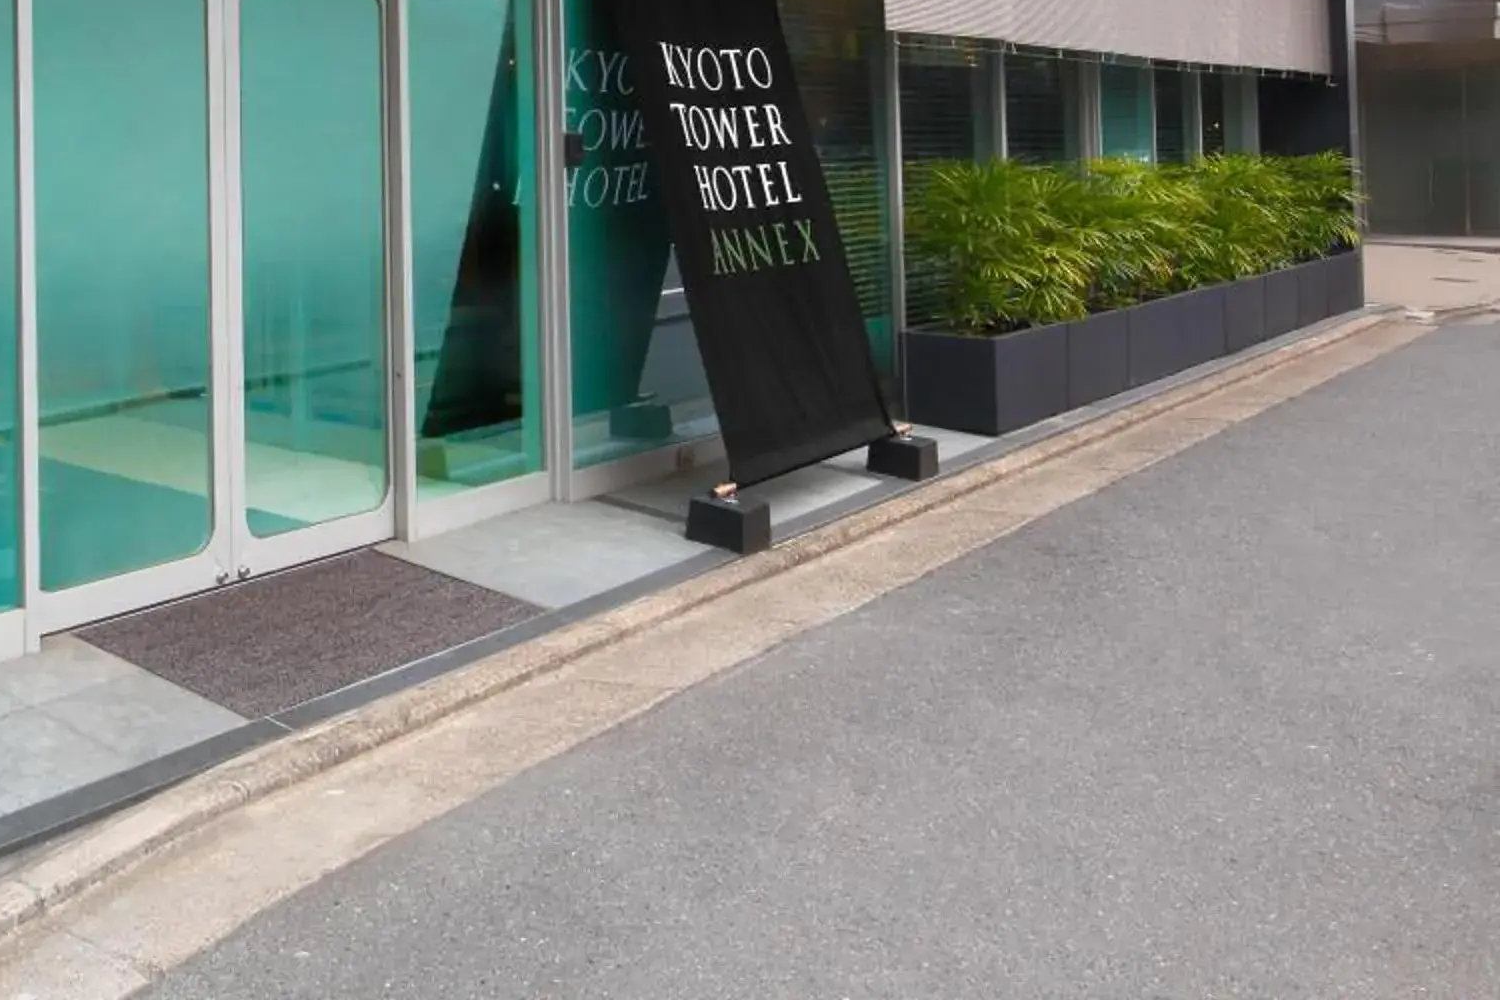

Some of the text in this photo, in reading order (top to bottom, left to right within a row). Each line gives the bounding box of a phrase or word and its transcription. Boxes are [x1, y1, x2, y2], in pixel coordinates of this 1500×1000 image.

[565, 48, 635, 95] KYO
[659, 41, 773, 92] KYOTO
[669, 103, 792, 151] TOWER
[693, 161, 803, 212] HOTEL
[710, 219, 821, 275] ANNEX
